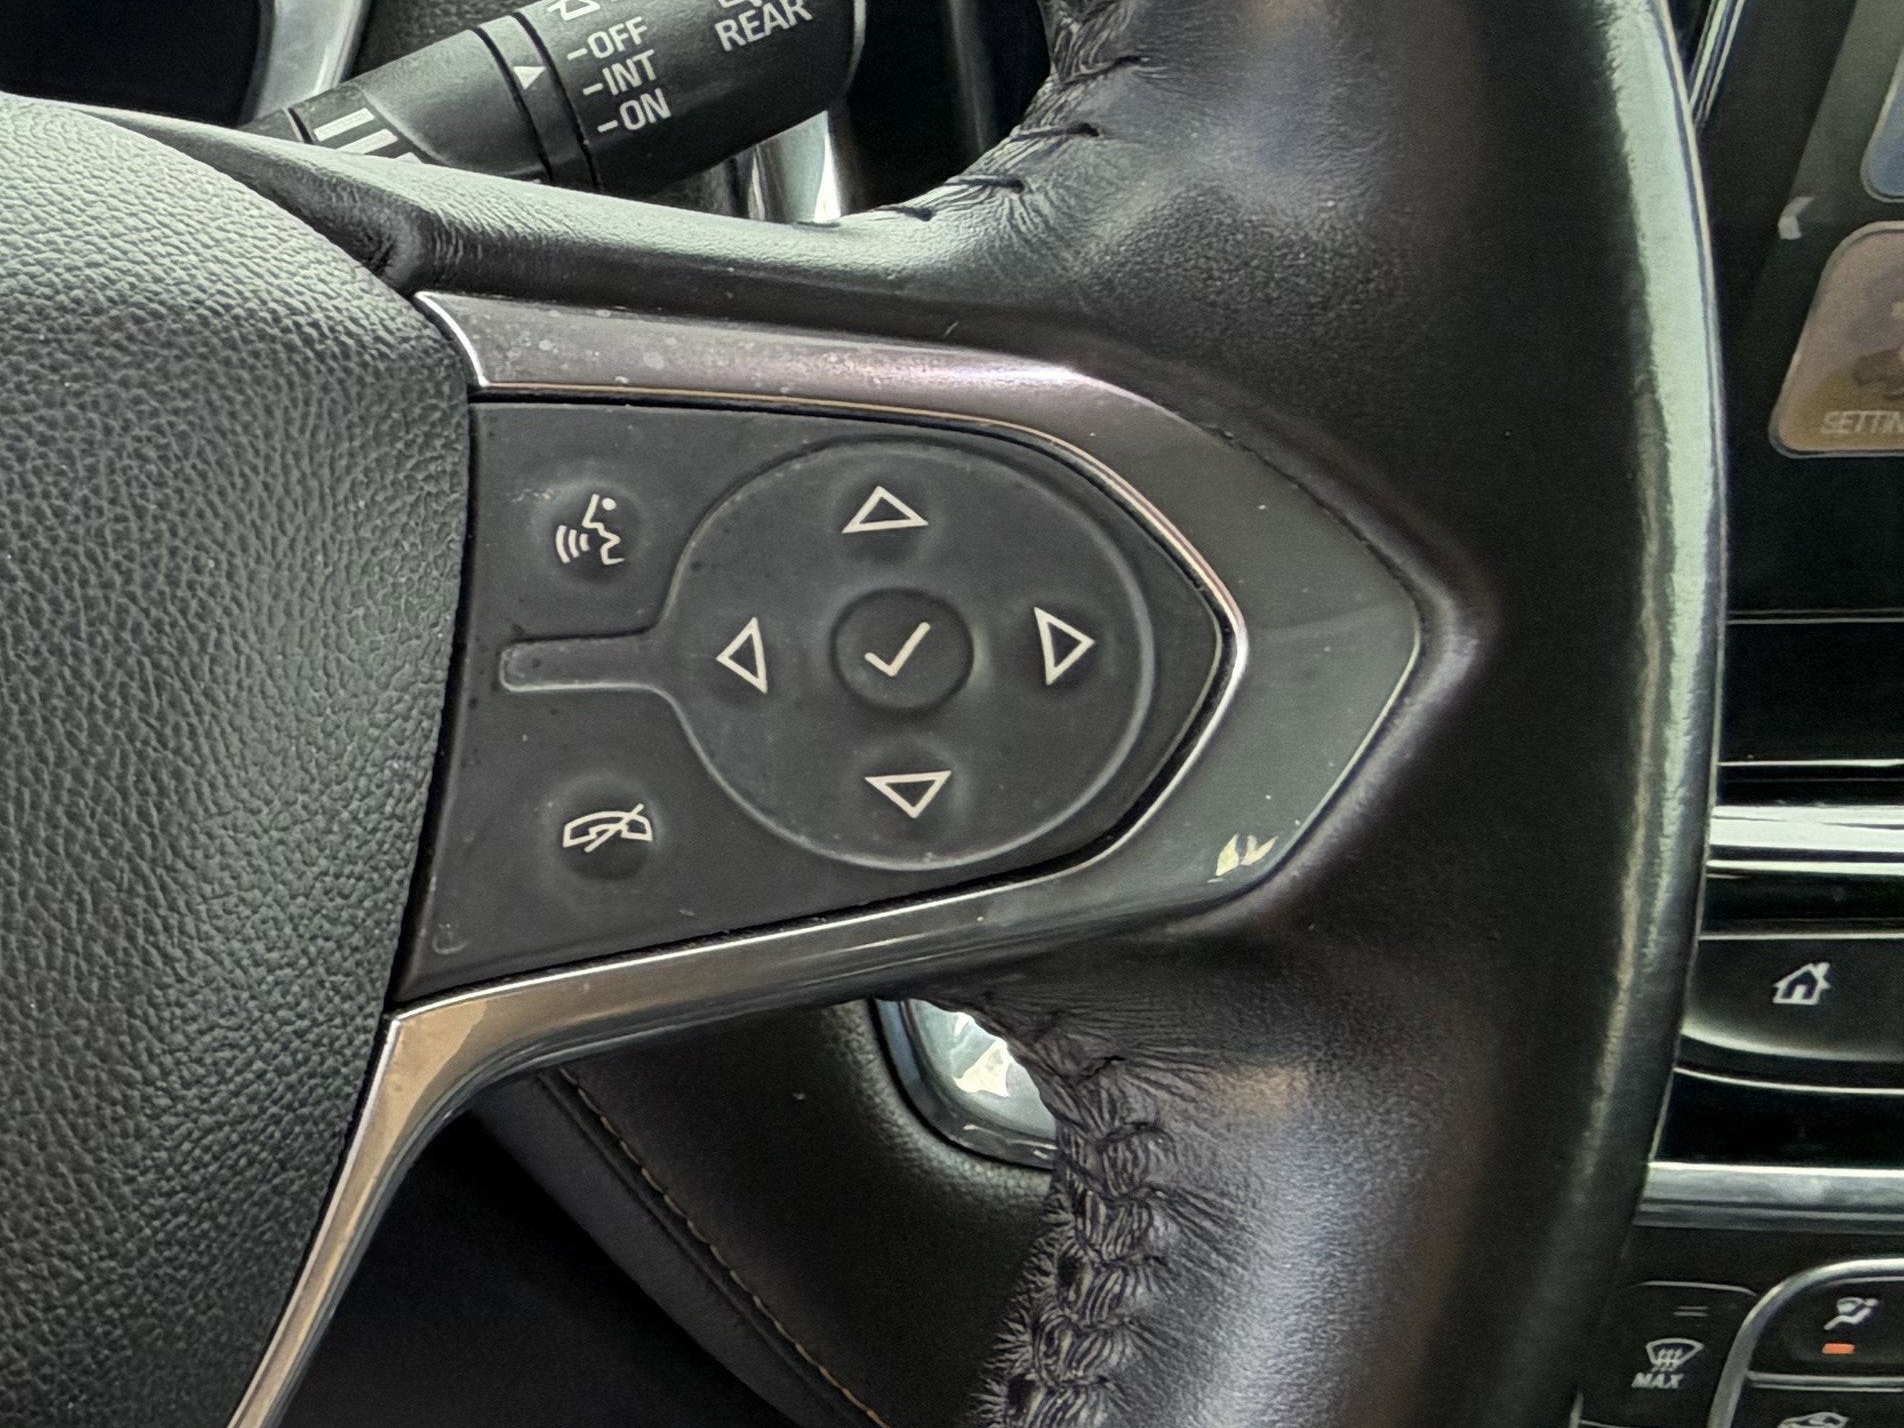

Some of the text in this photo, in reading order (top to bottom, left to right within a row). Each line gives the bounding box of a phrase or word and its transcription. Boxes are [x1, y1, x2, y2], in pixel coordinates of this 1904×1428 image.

[587, 17, 647, 60] OFF
[604, 50, 655, 96] INT
[619, 88, 671, 132] ON
[1631, 1373, 1685, 1389] MAX
